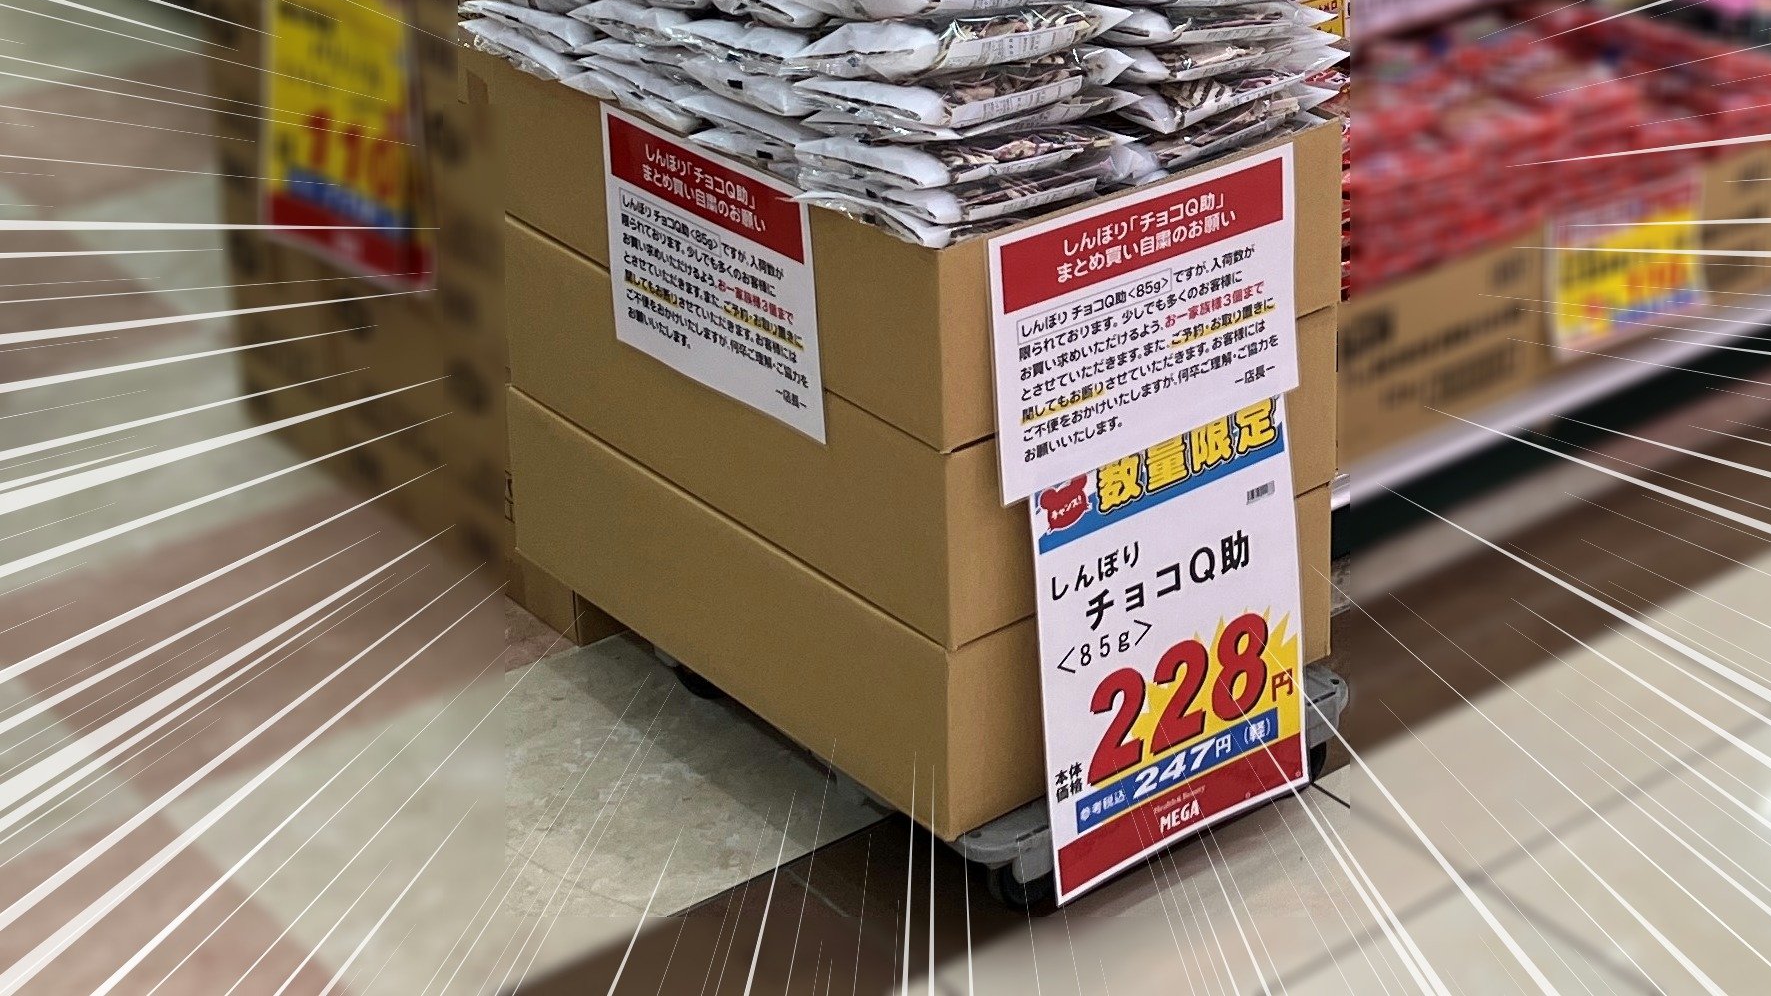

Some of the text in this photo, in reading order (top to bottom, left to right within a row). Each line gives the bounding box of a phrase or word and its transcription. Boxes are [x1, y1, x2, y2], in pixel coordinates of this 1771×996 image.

[1056, 210, 1237, 284] まとめ買い自粛のお願い
[1063, 191, 1225, 257] しんぼり「チョコQ助」
[1024, 415, 1123, 463] お願いいたします。
[1096, 394, 1279, 514] 数量限定
[1051, 540, 1140, 601] しんぼり
[1086, 529, 1251, 632] チョコQ助
[1055, 761, 1083, 786] 本体
[1056, 777, 1084, 803] 価格
[1159, 798, 1200, 834] MEGA
